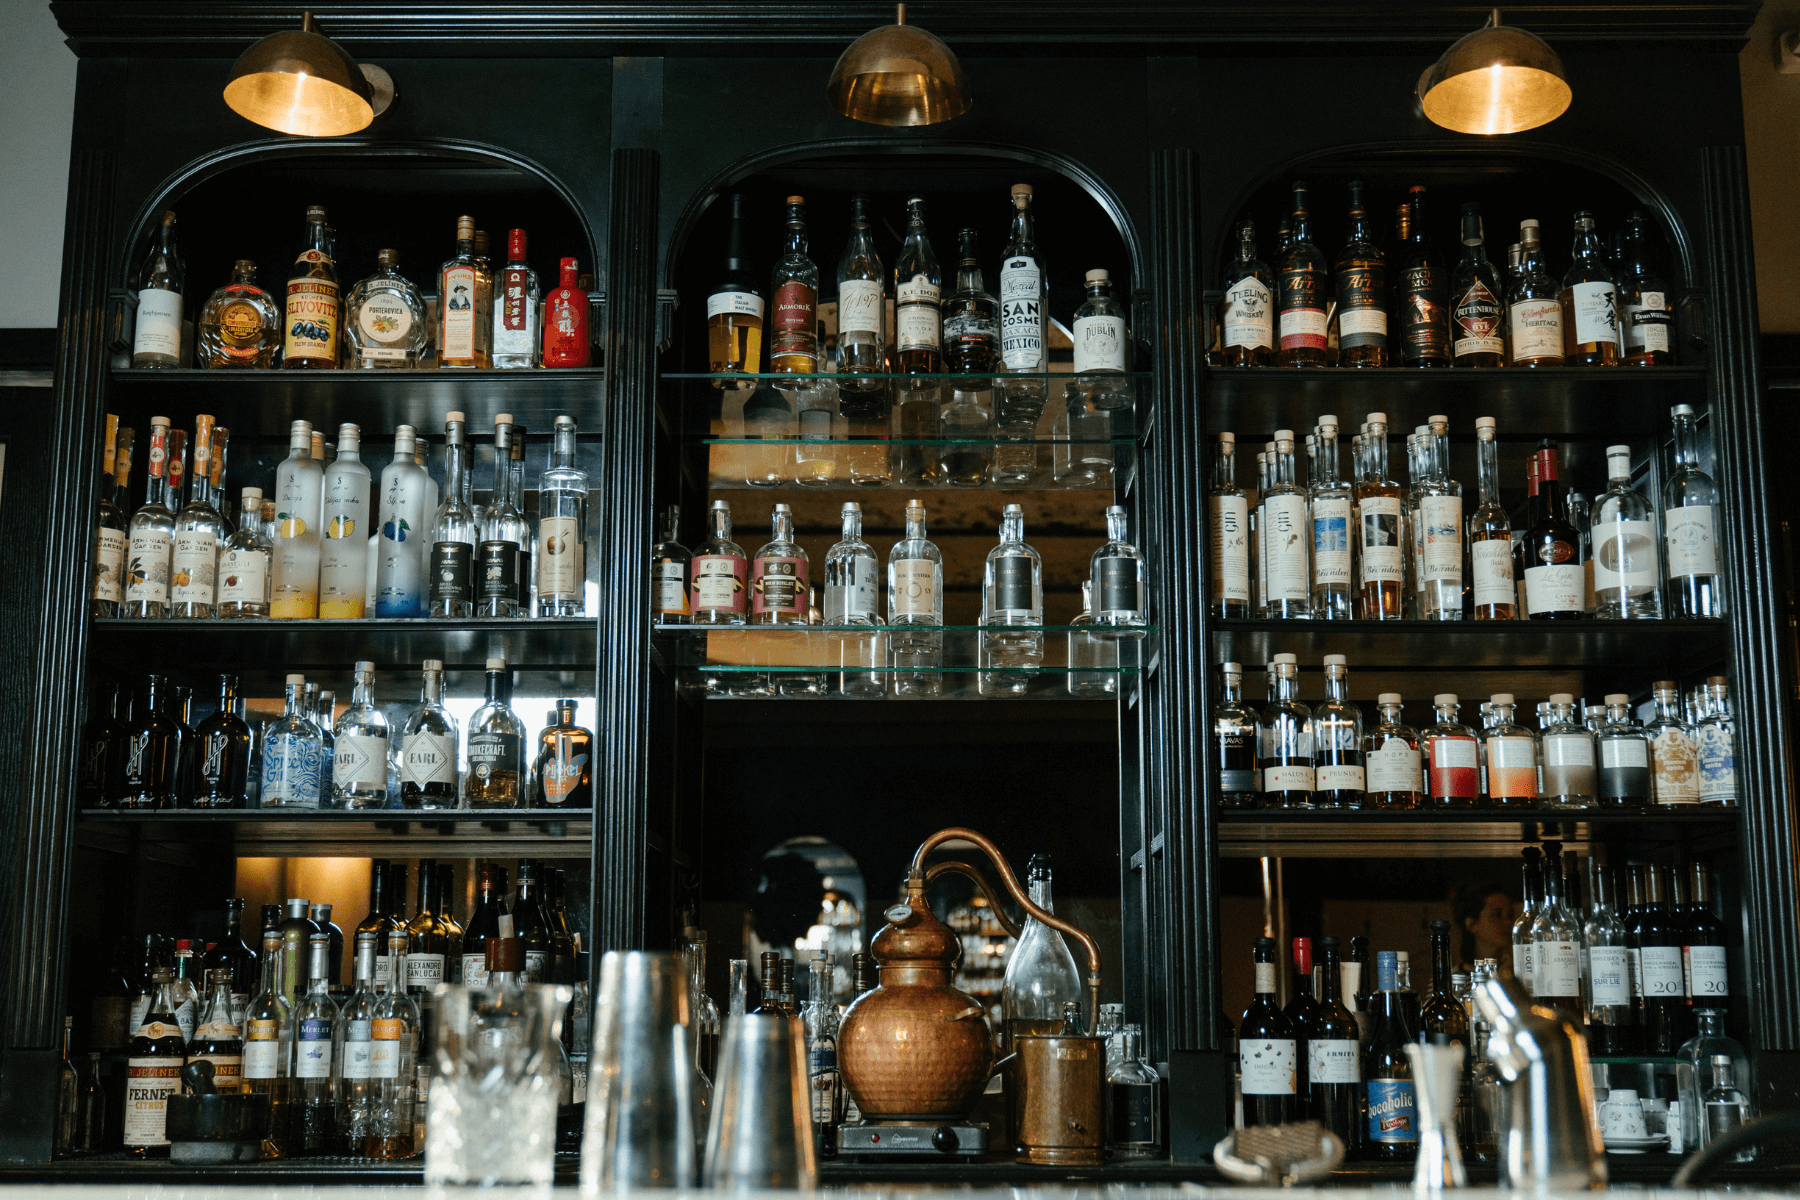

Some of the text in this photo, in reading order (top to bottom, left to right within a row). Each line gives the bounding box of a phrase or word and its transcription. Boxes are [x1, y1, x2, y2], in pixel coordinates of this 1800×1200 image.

[1003, 279, 1037, 293] Mezcal
[1231, 289, 1268, 304] TEELING
[287, 301, 337, 318] SLIVOVITZ
[1003, 301, 1039, 318] SAN
[1235, 310, 1264, 318] WHISKEY
[1457, 305, 1500, 317] RITTENHOUSE
[1002, 316, 1039, 328] COSME
[1525, 320, 1559, 328] HERITAGE
[1003, 328, 1040, 337] OAXACA
[1086, 326, 1116, 340] DUBLIN
[1003, 338, 1040, 352] MEXICO
[1224, 511, 1239, 533] gin
[1277, 511, 1293, 533] gin
[132, 537, 166, 545] ARMNIAN
[178, 539, 212, 547] ARMNIAN
[1556, 567, 1573, 584] Gin
[1219, 737, 1244, 745] BAVAS
[334, 753, 357, 765] EARL
[410, 753, 438, 765] EARL
[407, 961, 442, 970] ALEXANDRO
[407, 969, 441, 978] SANLUCAR
[248, 1025, 276, 1033] MERLET
[301, 1025, 330, 1033] MERLET
[372, 1025, 397, 1033] MERLET
[215, 1066, 239, 1075] INEK
[129, 1088, 176, 1101] FERNET
[135, 1101, 164, 1110] CITRUS
